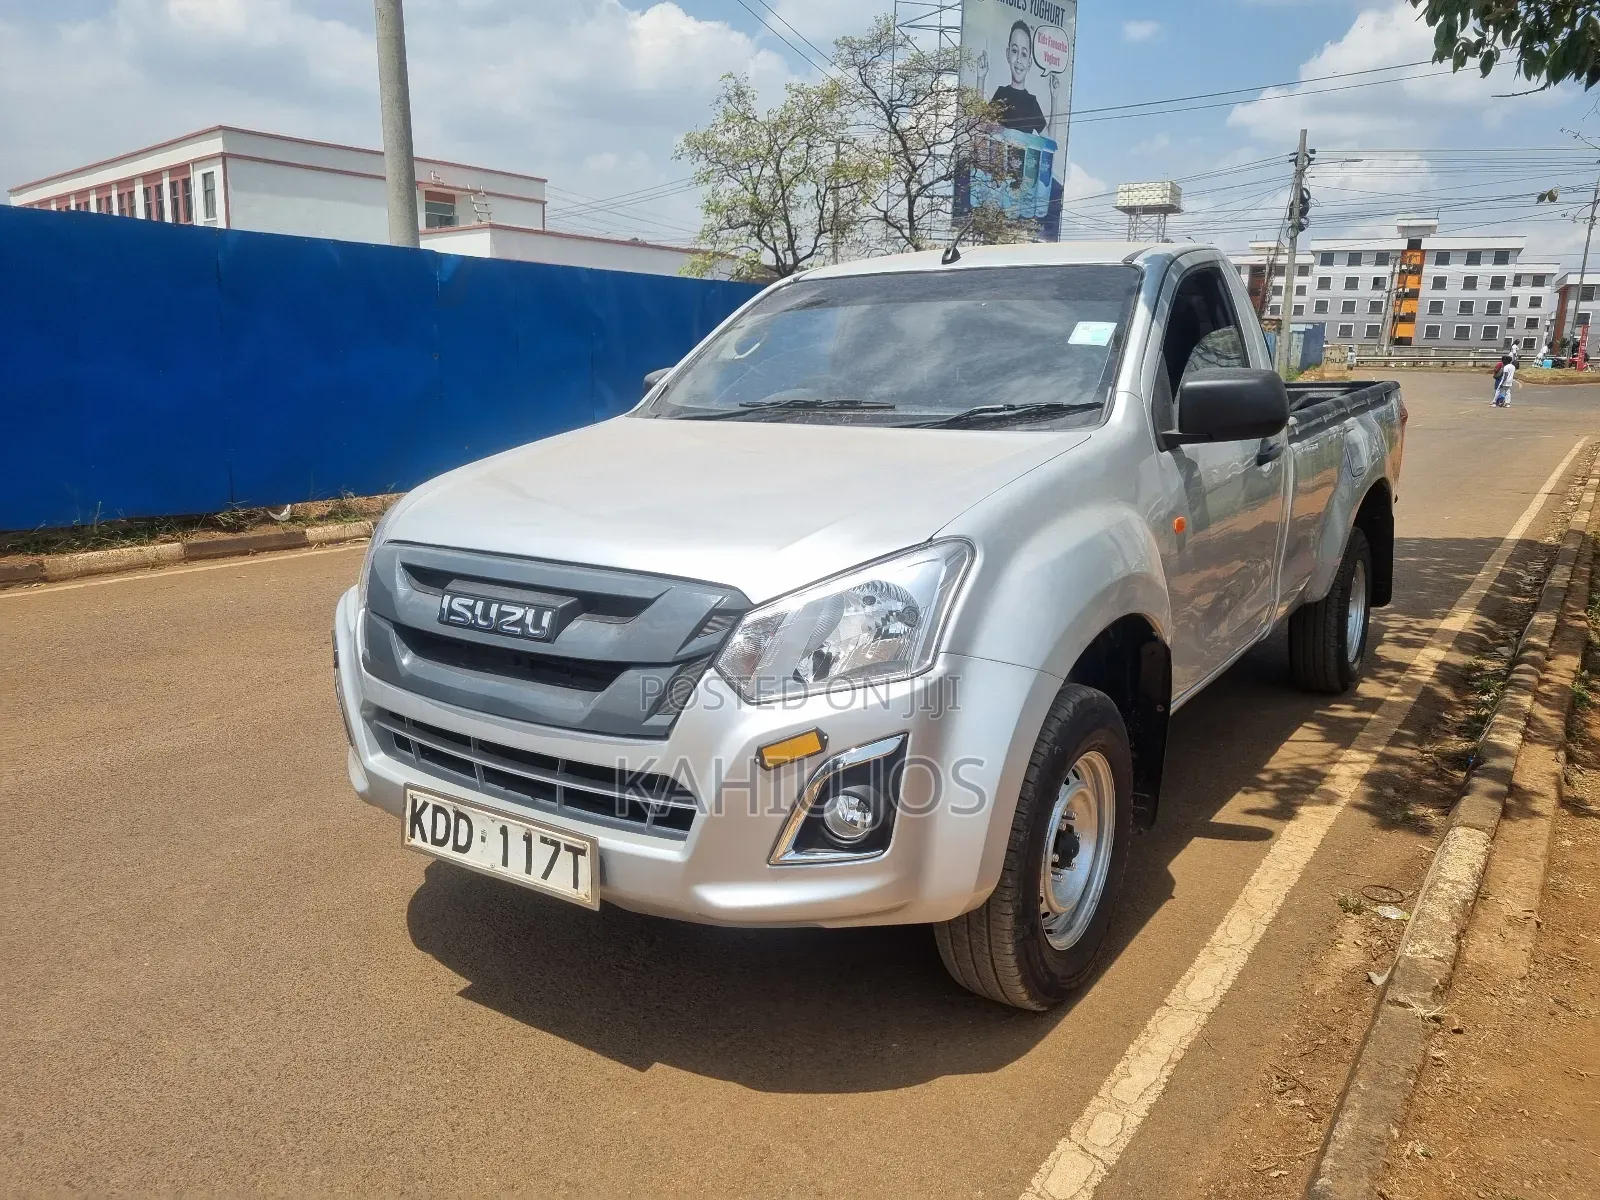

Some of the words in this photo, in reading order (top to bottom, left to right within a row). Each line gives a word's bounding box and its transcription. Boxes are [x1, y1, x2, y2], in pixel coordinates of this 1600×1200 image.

[1029, 0, 1065, 27] YOGHURT
[1044, 51, 1060, 67] Yoghurt
[441, 594, 553, 638] ISUZU
[408, 797, 474, 855] KDD
[499, 824, 587, 890] 117T
